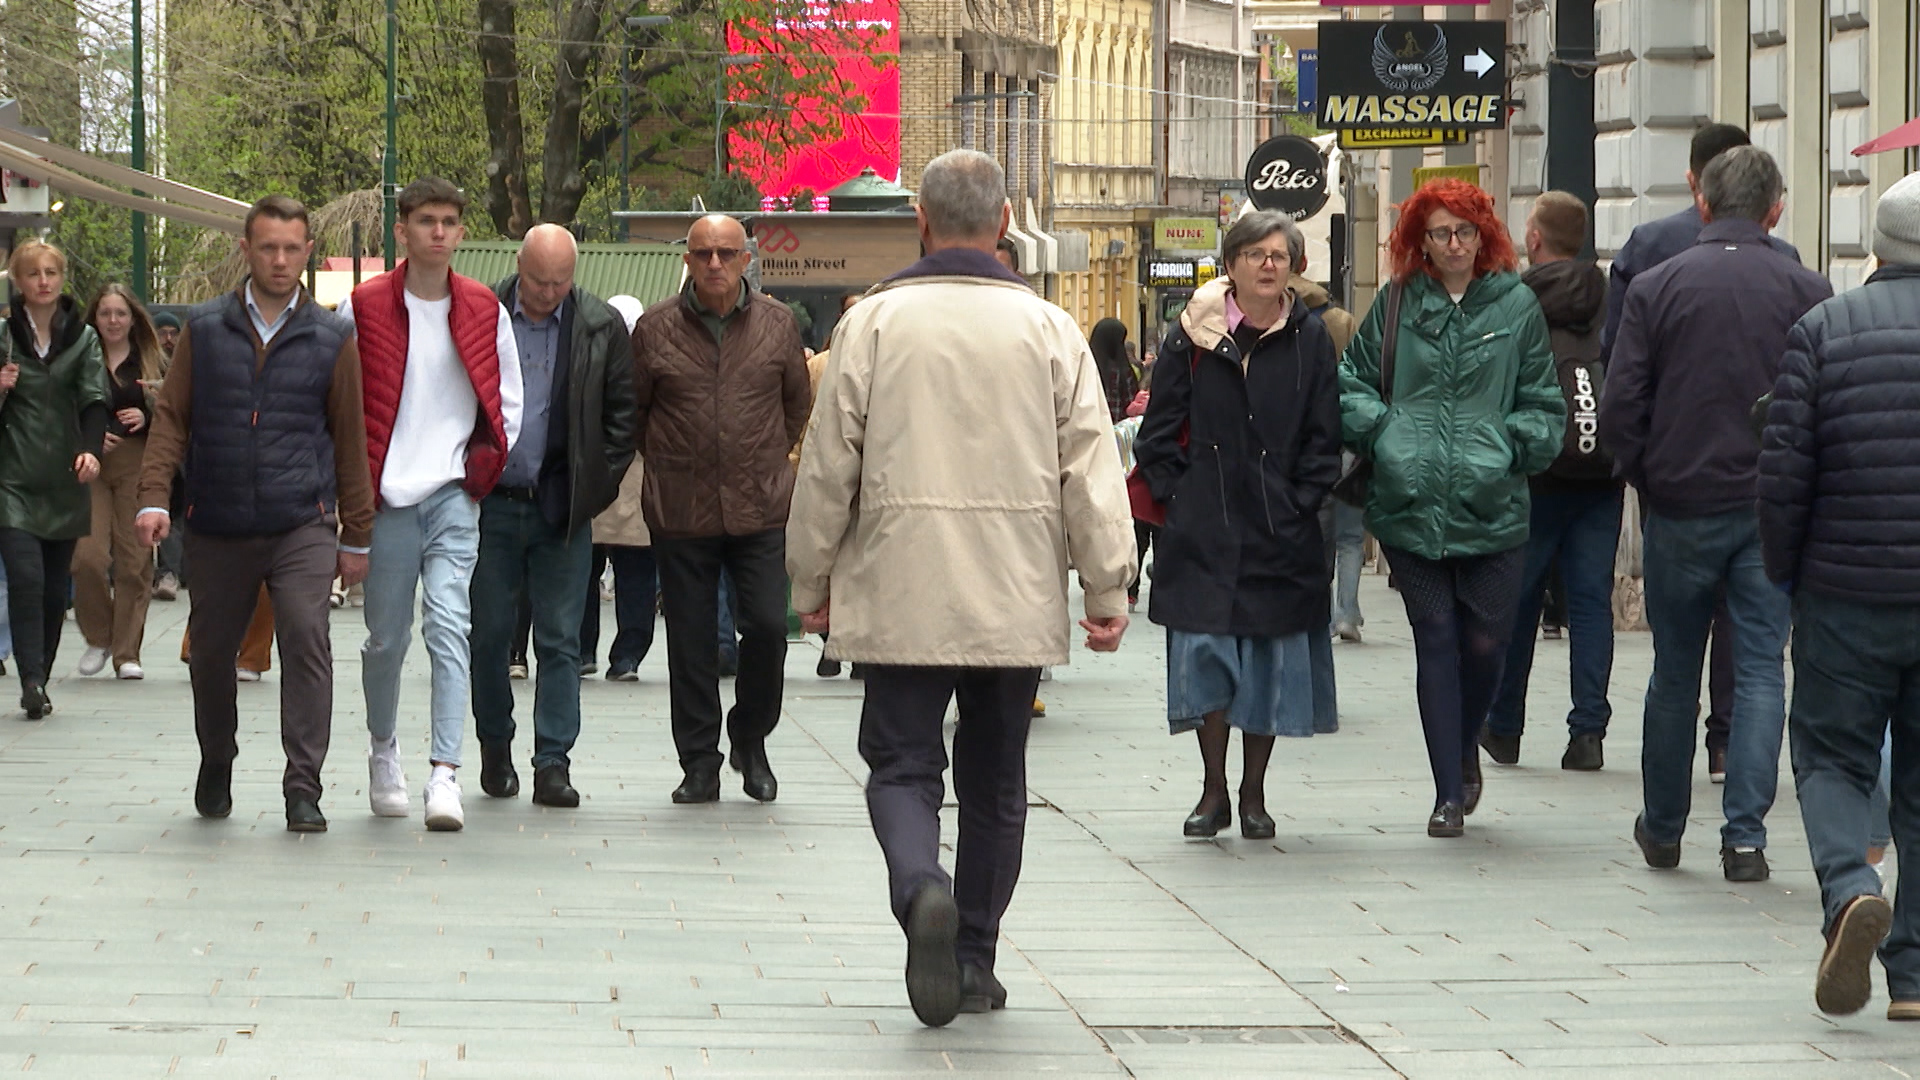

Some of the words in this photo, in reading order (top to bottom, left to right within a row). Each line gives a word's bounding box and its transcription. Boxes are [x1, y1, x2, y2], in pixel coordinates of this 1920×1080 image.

[1396, 63, 1424, 71] ANGEL
[1324, 95, 1501, 123] MASSAGE
[1253, 159, 1319, 191] Peko
[762, 258, 799, 269] Main
[804, 258, 847, 270] Street
[1150, 263, 1194, 277] FABRIKA
[1574, 367, 1598, 455] adidas
